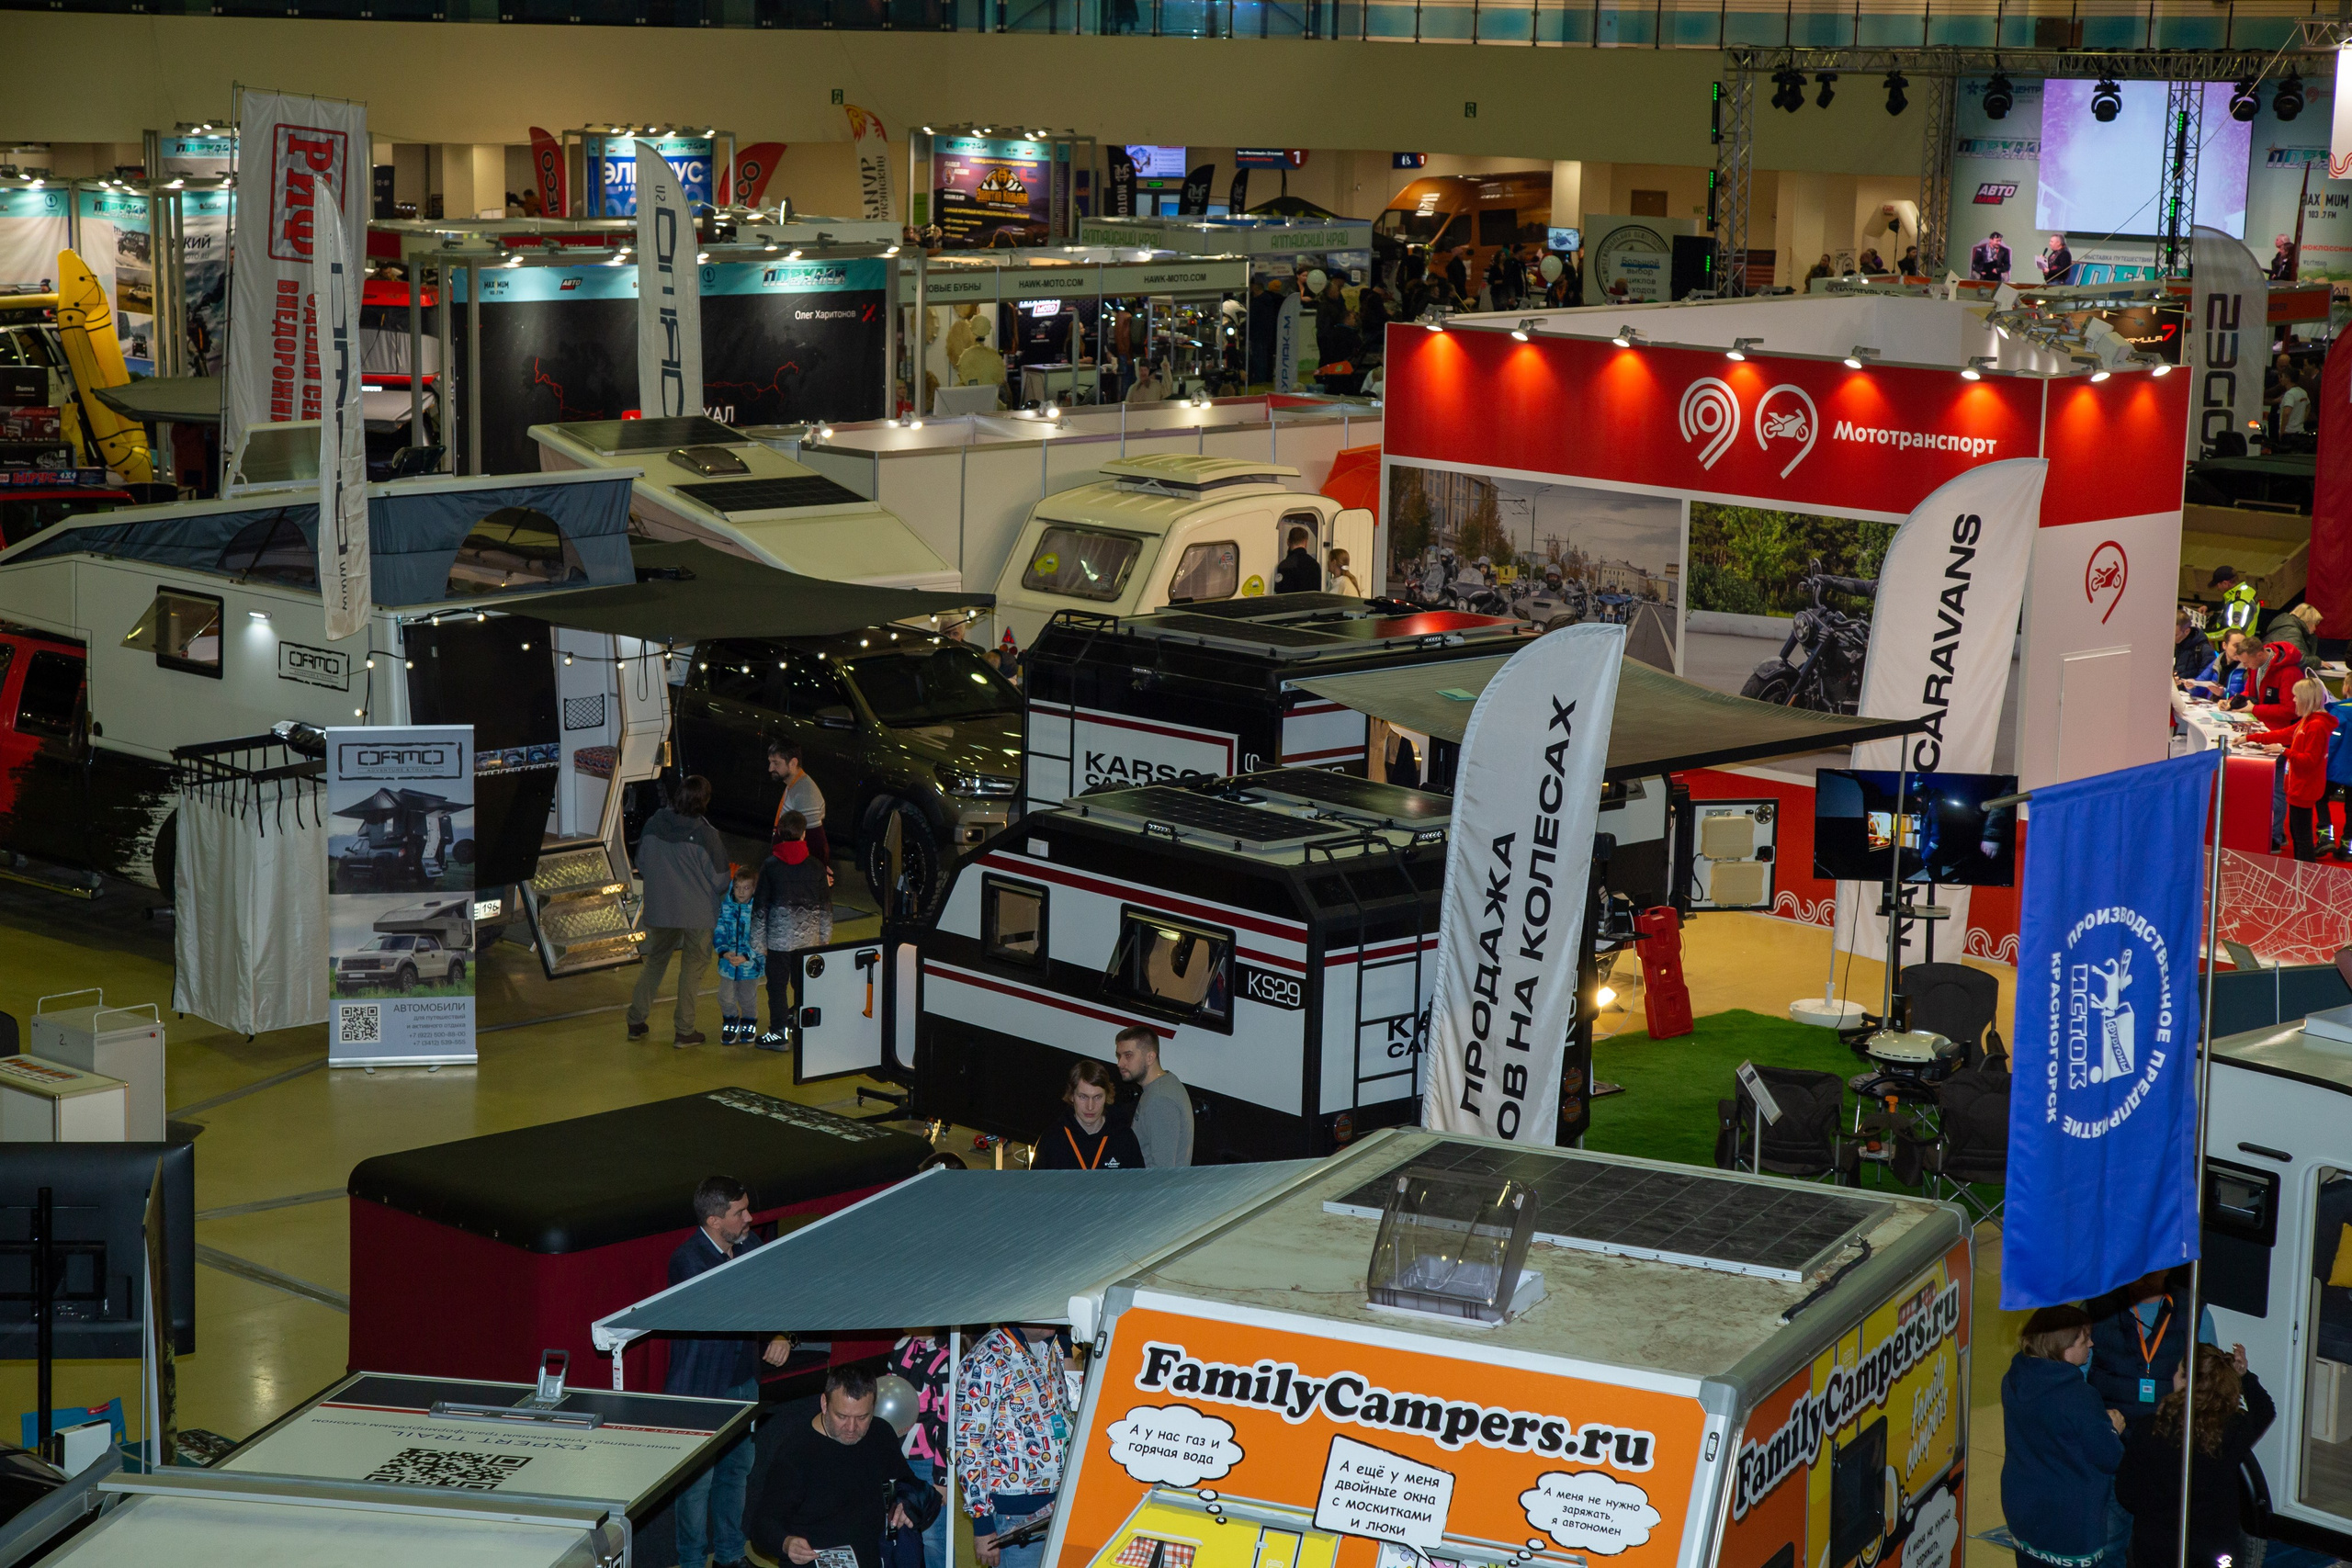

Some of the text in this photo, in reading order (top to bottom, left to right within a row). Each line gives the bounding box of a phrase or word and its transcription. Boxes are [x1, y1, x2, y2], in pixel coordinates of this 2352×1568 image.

[1978, 185, 2017, 197] АВТО
[1693, 206, 1705, 214] WC
[954, 282, 981, 291] БУБНЫ
[1019, 278, 1083, 288] HAWK-MOTO.COM
[1144, 273, 1206, 283] HAWK-MOTO.COM
[795, 310, 855, 320] Олег Харитонов
[1833, 420, 1997, 458] Мототранспорт
[13, 472, 57, 484] ШРУС
[59, 471, 76, 479] 4X4
[1913, 513, 1983, 773] CARAVANS
[1519, 693, 1577, 963] КОЛЕСАХ
[1459, 831, 1518, 1117] ПРОДАЖА
[1248, 970, 1302, 1008] KS29
[393, 1003, 466, 1013] АВТОМОБИЛИ
[425, 1013, 466, 1021] путешествий
[1505, 976, 1540, 1053] НА
[2062, 907, 2173, 1139] ПРОИЗВОДСТВЕННОЕ ПРЕДПРИЯТИЕ
[2069, 964, 2089, 1090] ИСТОК
[2047, 952, 2062, 1123] КРАСНОГОРСК
[2105, 1020, 2132, 1073] ФУРГОНЫ
[1139, 1345, 1654, 1468] FamilyCampers.ru
[1735, 1280, 1959, 1517] FamilyCampers.ru
[311, 1417, 368, 1427] салоном
[369, 1423, 499, 1438] трансформируемым
[390, 1430, 588, 1451] EXPERT TRAIL
[503, 1433, 582, 1444] уникальным
[594, 1439, 681, 1451] мини-кемпер
[1130, 1424, 1220, 1450] А у нас газ и
[1128, 1441, 1214, 1465] горячая вода
[1340, 1461, 1440, 1488] А ещё у меня
[1334, 1478, 1436, 1506] двойные окна
[1544, 1487, 1641, 1513] А меня не нужно
[1332, 1497, 1432, 1523] с москитками
[1562, 1504, 1614, 1523] заряжать,
[1351, 1518, 1406, 1537] и люки
[1551, 1517, 1622, 1537] я автономен
[2027, 1547, 2074, 1567] JEANS
